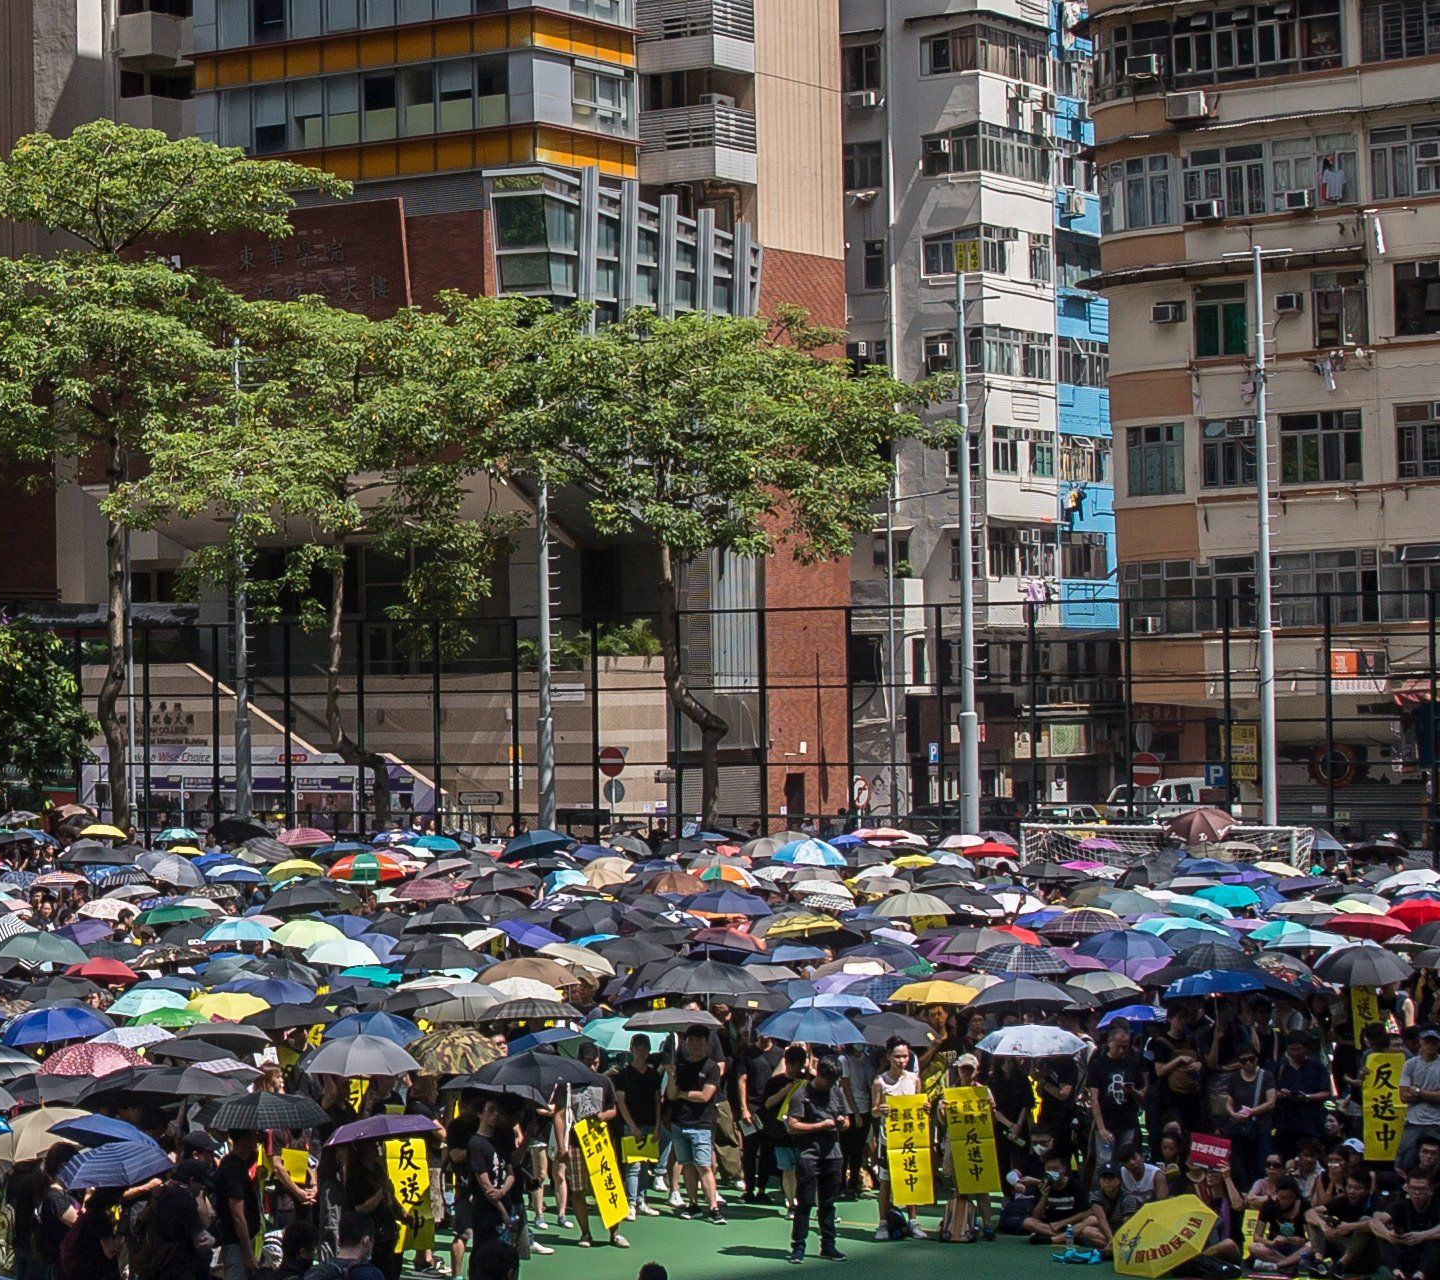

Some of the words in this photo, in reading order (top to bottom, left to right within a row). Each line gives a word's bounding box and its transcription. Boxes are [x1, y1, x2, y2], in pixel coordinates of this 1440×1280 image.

[1209, 766, 1223, 785] P
[1372, 1062, 1397, 1150] 反送中
[901, 1136, 918, 1192] 反送中
[966, 1129, 982, 1181] 反送中
[399, 1139, 425, 1237] 反送中
[600, 1156, 618, 1209] 反送中
